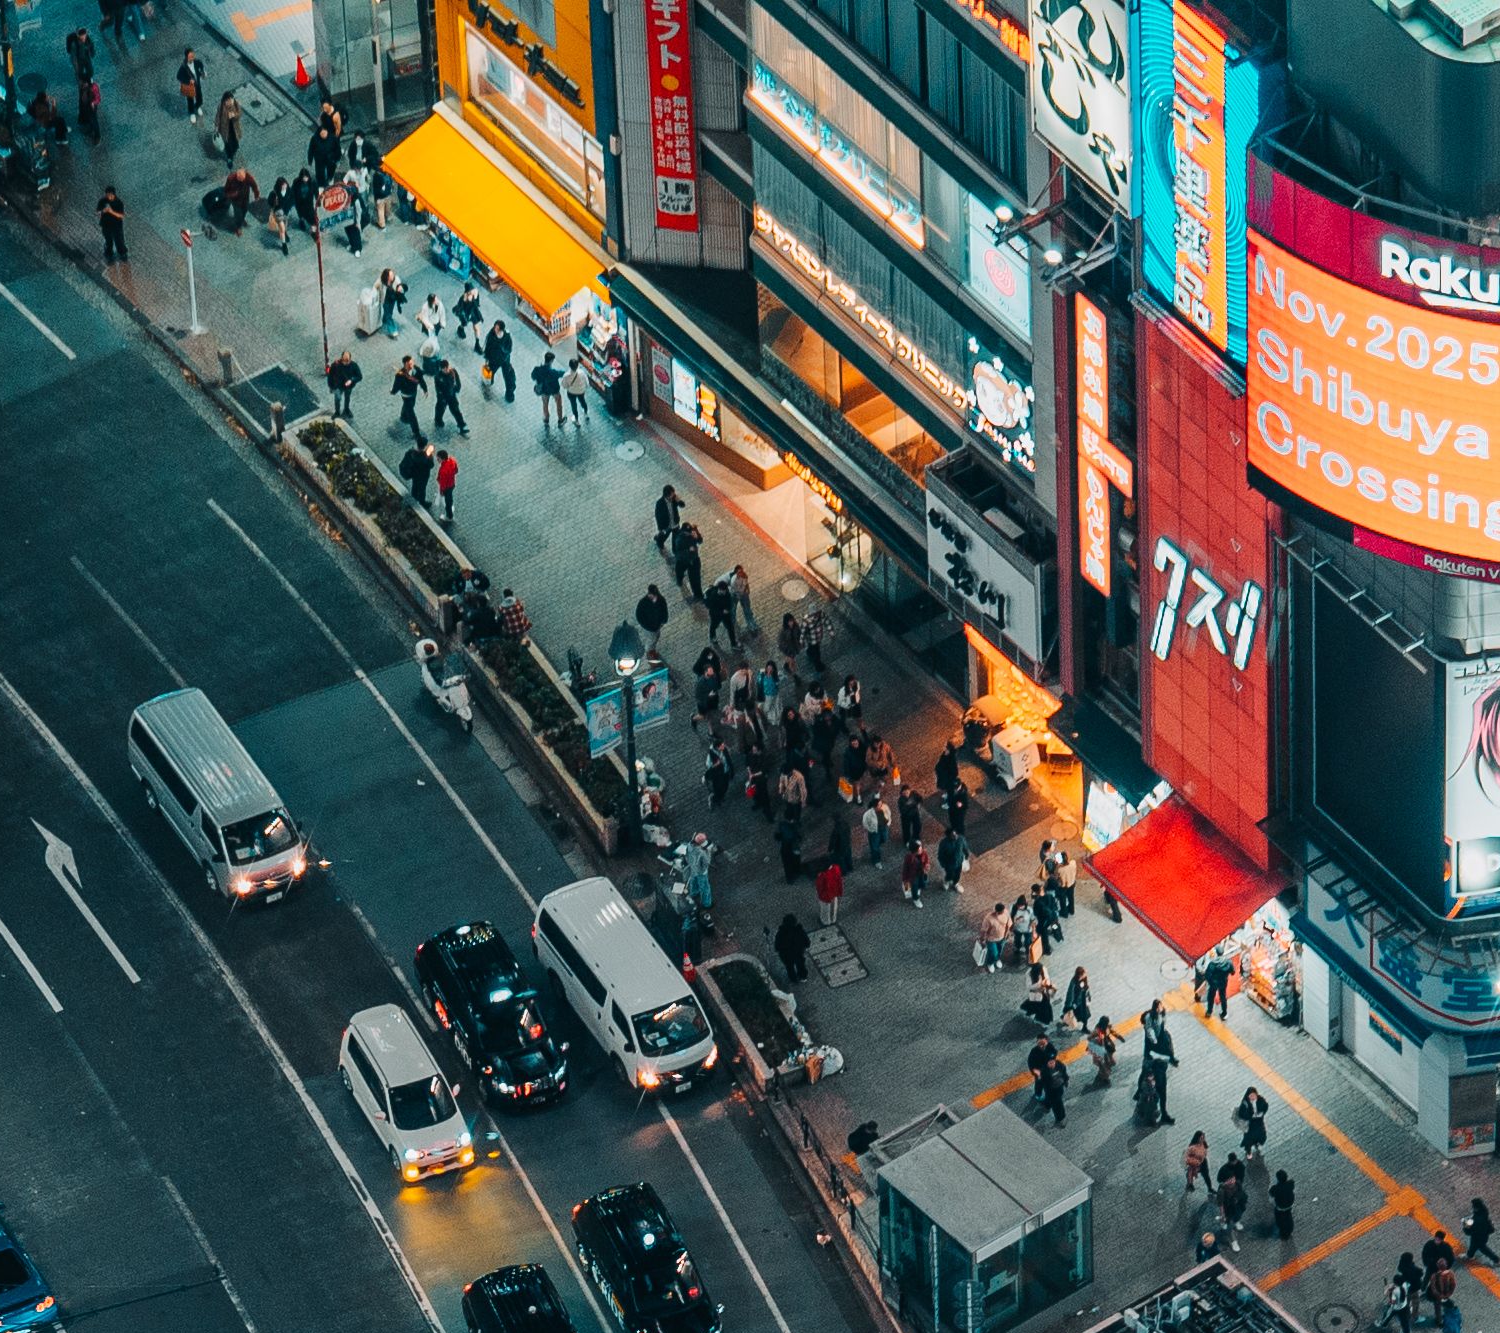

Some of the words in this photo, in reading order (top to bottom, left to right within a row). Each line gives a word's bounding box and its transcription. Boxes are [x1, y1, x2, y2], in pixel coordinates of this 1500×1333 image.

[1173, 29, 1213, 333] 三千里薬品
[1255, 254, 1500, 386] Nov.2025
[1255, 326, 1491, 461] Shibuya
[1423, 553, 1485, 578] Rakuten
